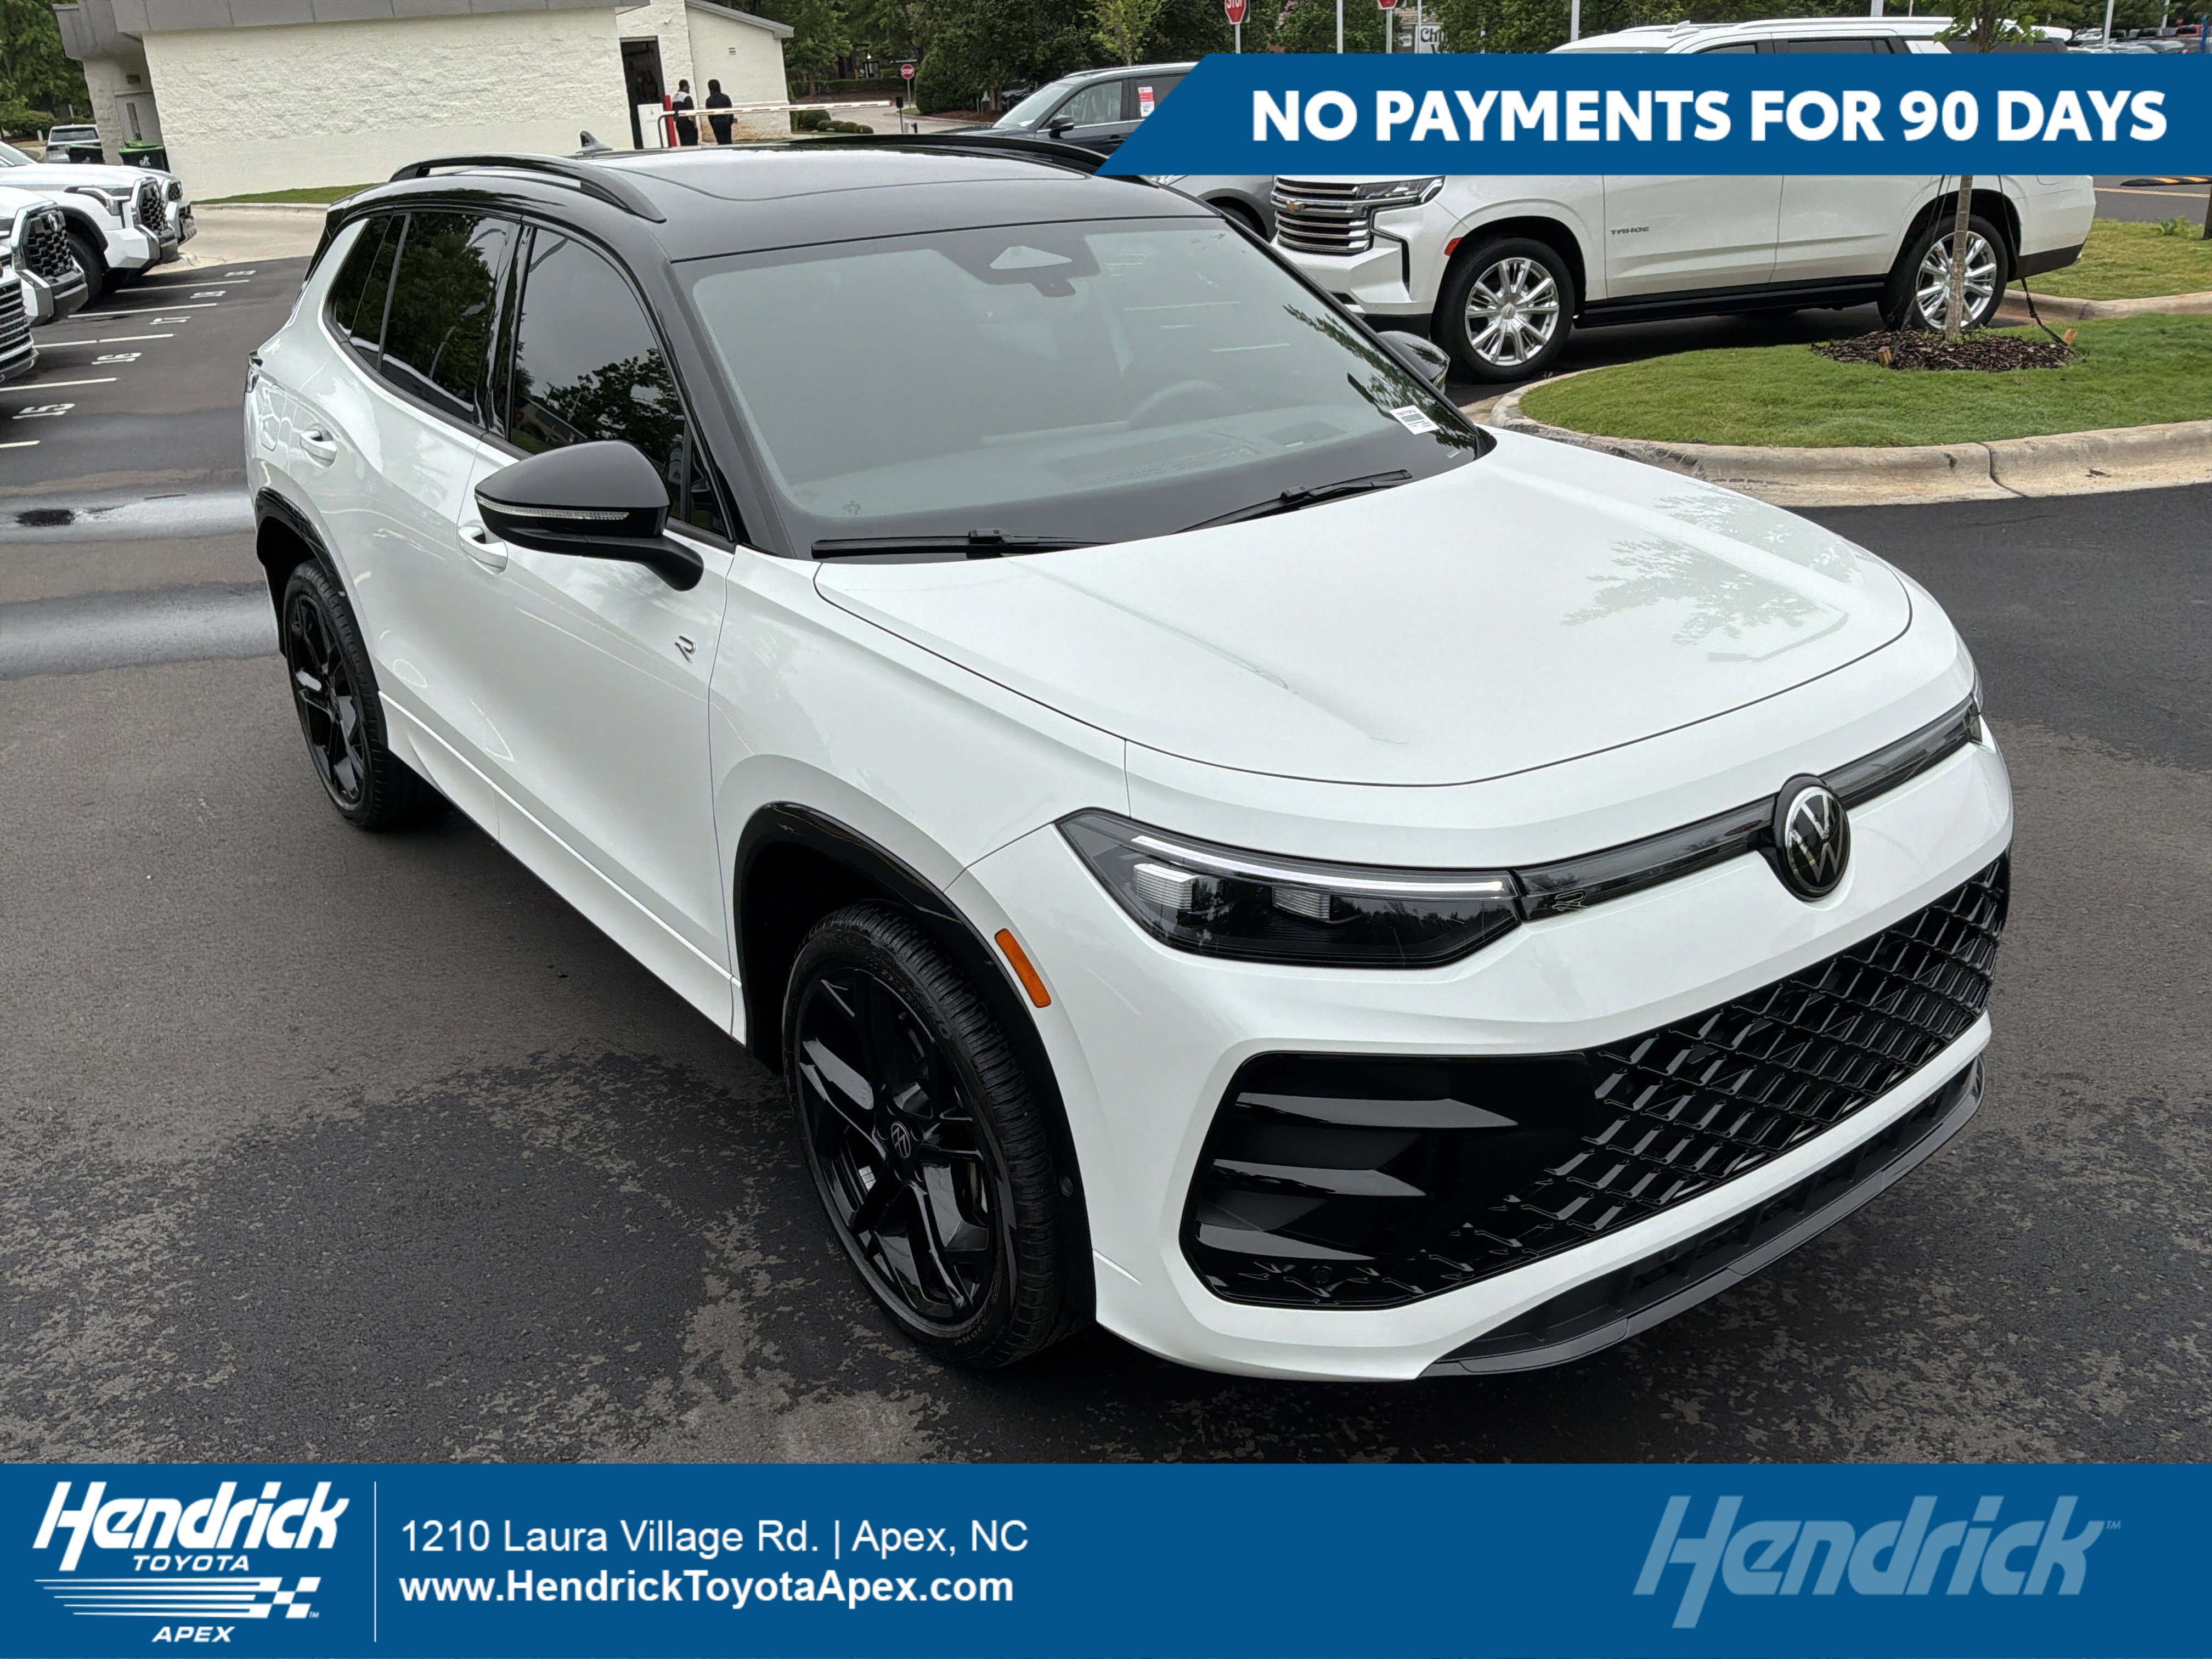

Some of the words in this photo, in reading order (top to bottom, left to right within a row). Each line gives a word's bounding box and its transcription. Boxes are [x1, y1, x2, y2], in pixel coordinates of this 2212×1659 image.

[1610, 226, 1650, 235] TAHOE
[91, 352, 142, 365] 16
[12, 403, 76, 419] 15
